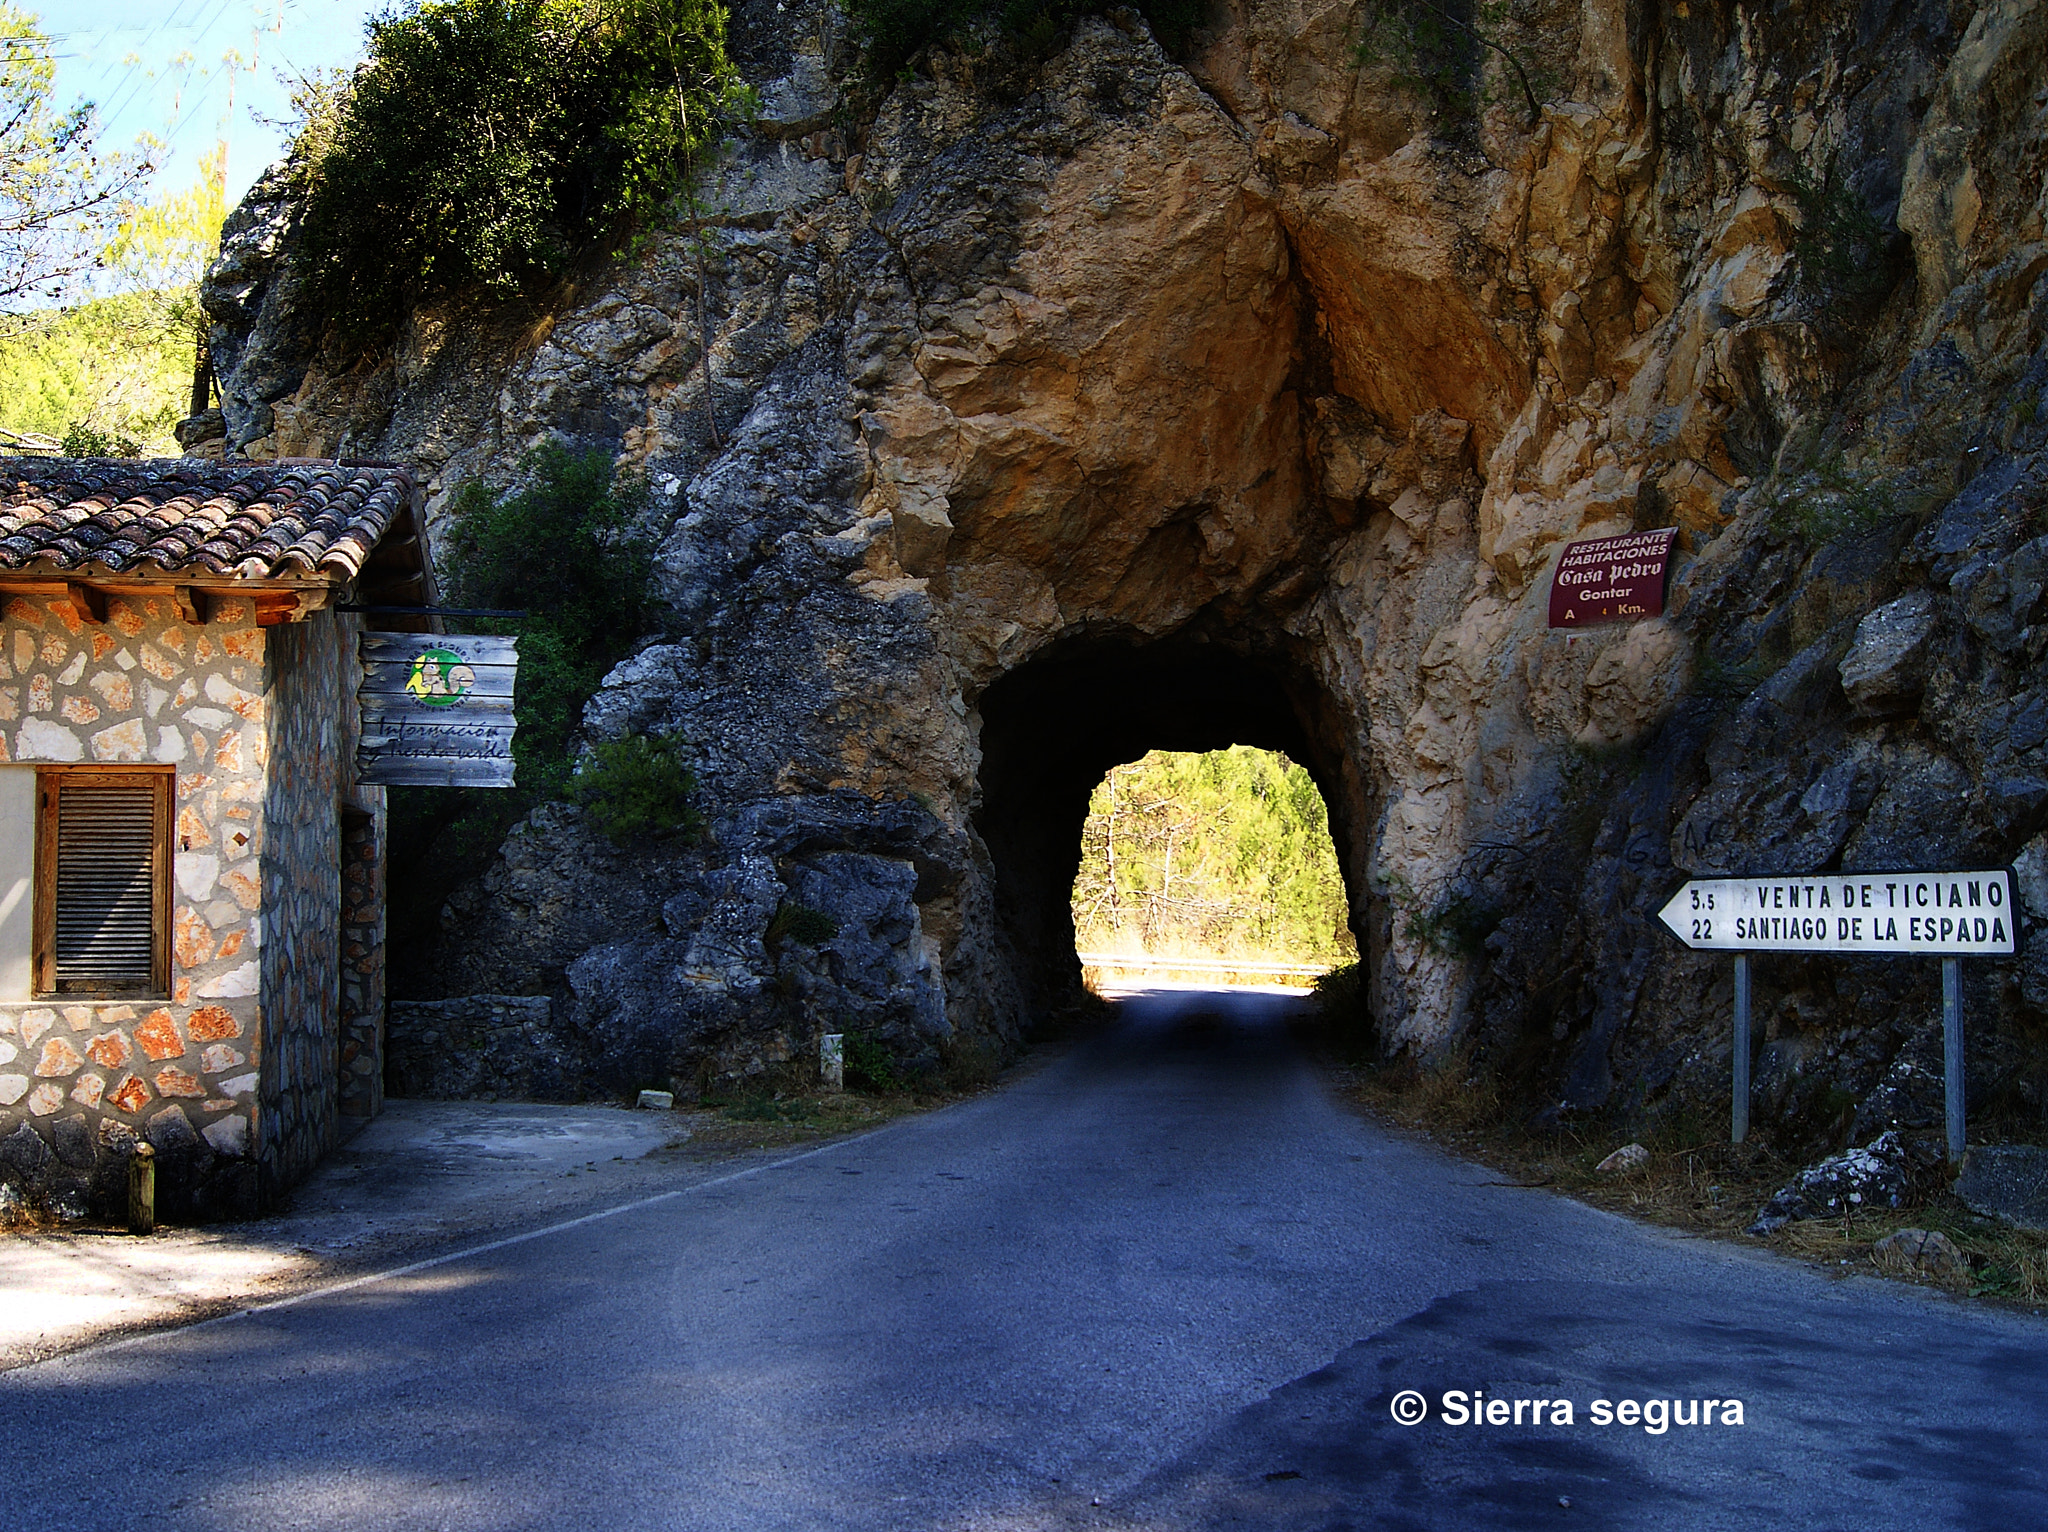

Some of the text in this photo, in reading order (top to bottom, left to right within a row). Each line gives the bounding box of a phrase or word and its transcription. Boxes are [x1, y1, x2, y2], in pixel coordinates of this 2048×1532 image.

[1570, 533, 1669, 554] RESTAURANTE
[1562, 544, 1667, 567] HABITACIONES
[1559, 562, 1661, 586] Casa Pedro
[1580, 588, 1633, 601] Gontar
[1564, 609, 1575, 620] A
[1618, 603, 1646, 615] Km.
[379, 716, 499, 741] Información
[1758, 885, 1831, 909] VENTA
[1843, 884, 1872, 908] DE
[1885, 880, 2003, 908] TICIANO
[1692, 917, 2008, 942] 22 SANTIAGO DE LA ESPADA
